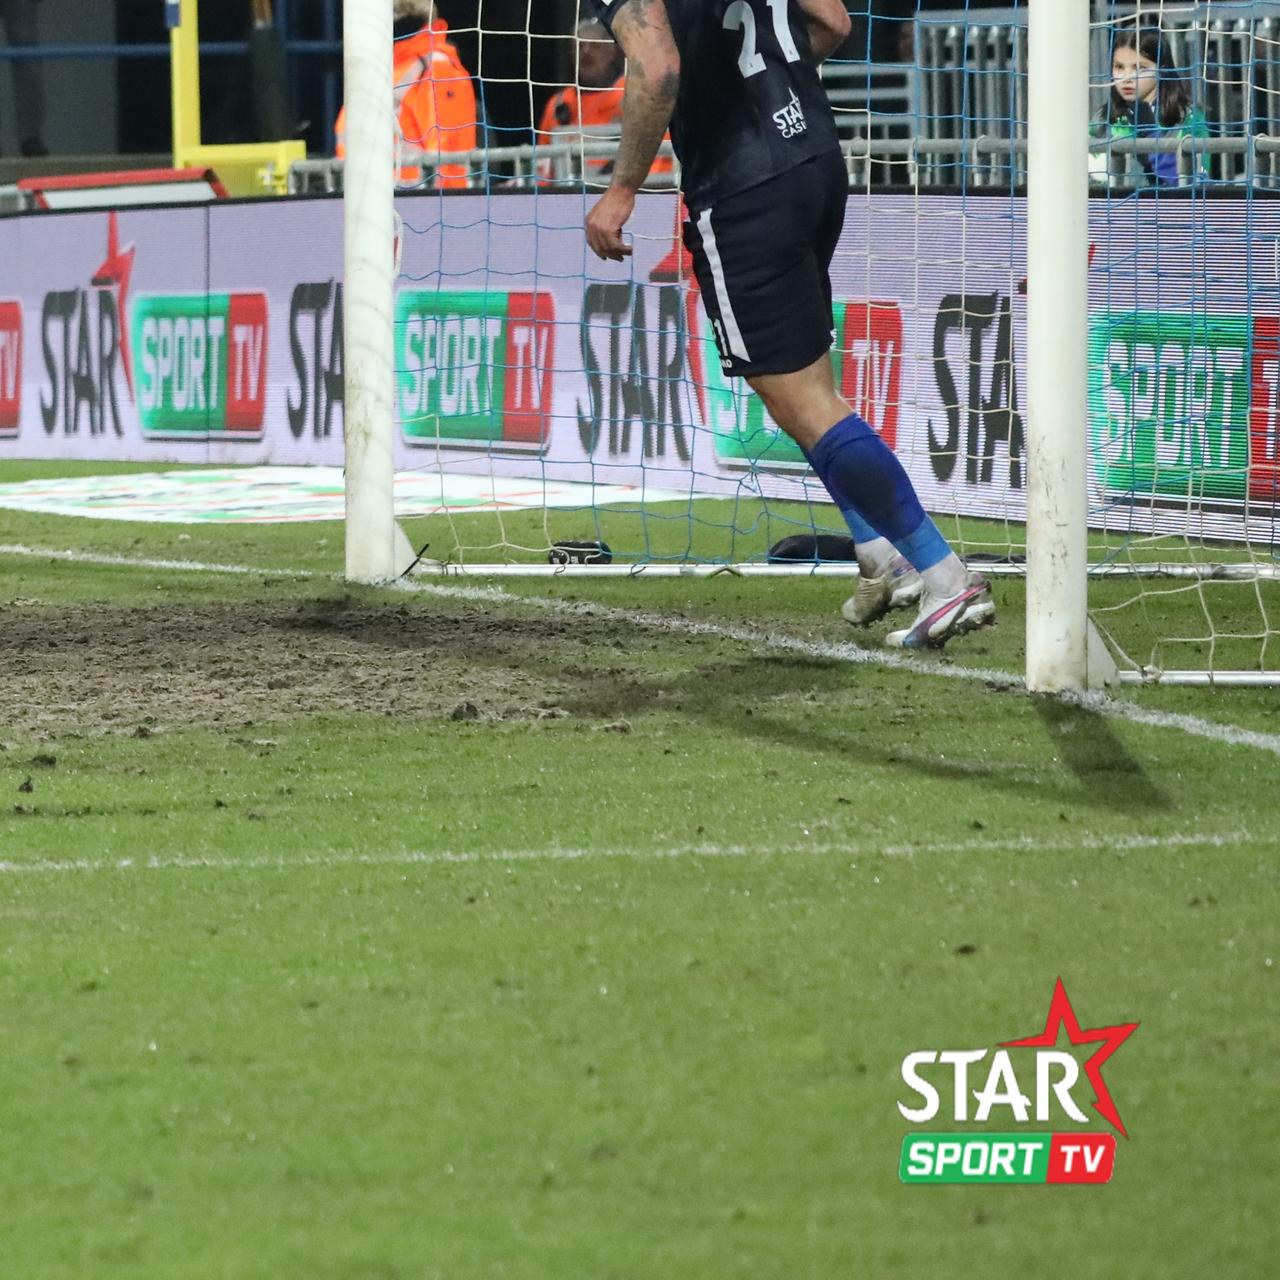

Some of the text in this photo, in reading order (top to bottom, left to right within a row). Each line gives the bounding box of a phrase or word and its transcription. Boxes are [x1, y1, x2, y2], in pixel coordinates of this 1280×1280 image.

[772, 104, 805, 131] STA
[40, 286, 264, 437] STAR SPORT TV
[286, 276, 550, 439] STA SPORT TV
[576, 283, 691, 461] STAR
[851, 340, 895, 433] TV
[927, 291, 1027, 489] STA
[1101, 340, 1246, 470] SPORT
